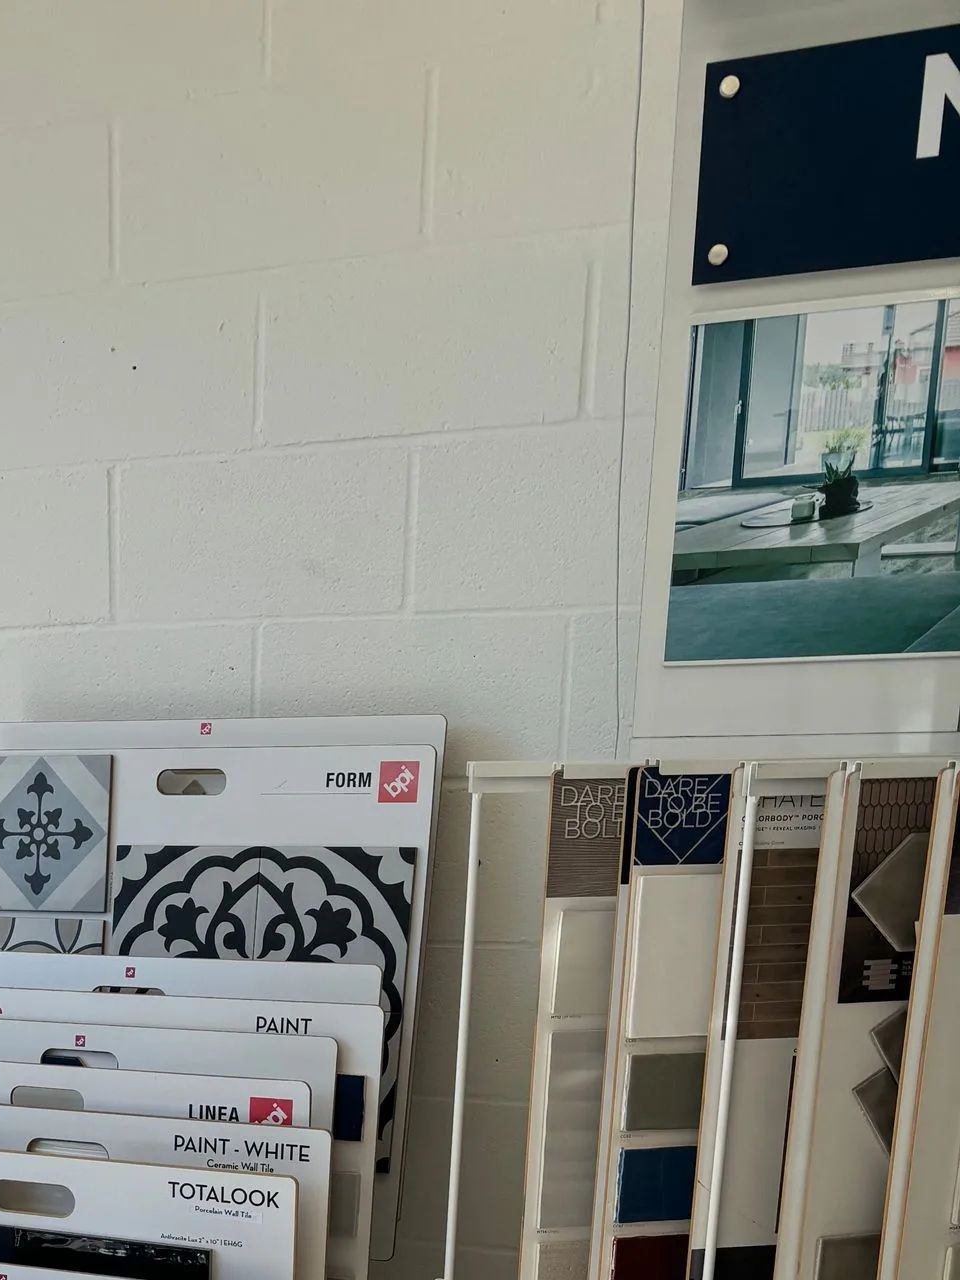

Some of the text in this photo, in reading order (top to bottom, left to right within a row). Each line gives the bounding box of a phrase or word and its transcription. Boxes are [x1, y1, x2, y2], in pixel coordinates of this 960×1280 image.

[325, 772, 372, 788] FORM
[383, 764, 415, 798] bpi
[561, 785, 626, 822] DARE TO
[645, 777, 723, 814] DARE TO BE
[647, 809, 713, 829] BOLD
[255, 1016, 313, 1035] PAINT
[188, 1103, 240, 1122] LINEA
[174, 1134, 310, 1163] PAINT WHITE
[206, 1158, 275, 1174] Ceramic Wall Tile
[167, 1181, 280, 1210] TOTALOOK
[194, 1205, 253, 1219] Porcelain Wall Tile
